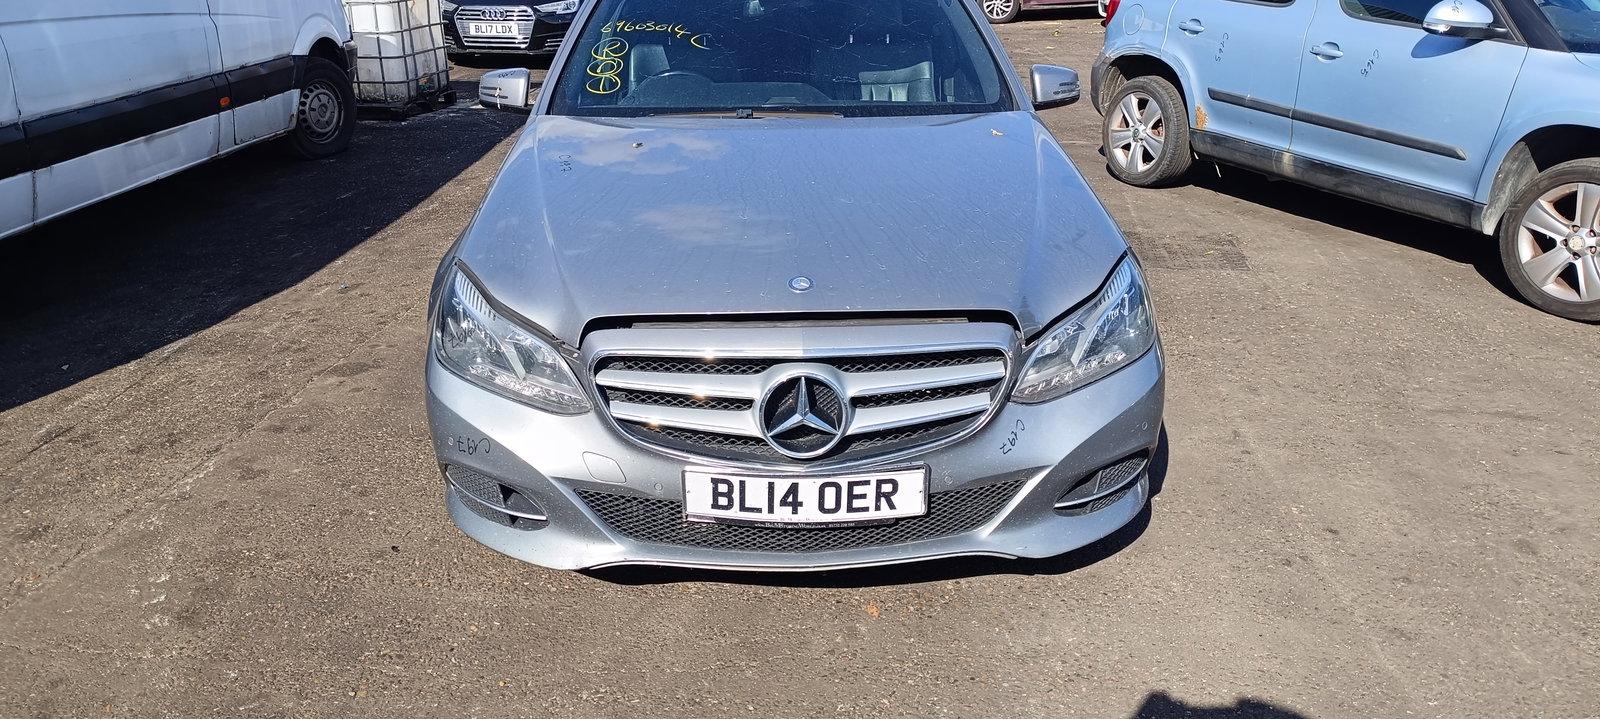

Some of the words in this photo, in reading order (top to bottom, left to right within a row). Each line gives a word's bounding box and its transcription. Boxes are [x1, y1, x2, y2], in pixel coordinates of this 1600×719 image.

[474, 24, 493, 34] BL17
[495, 25, 513, 34] LDX
[457, 436, 490, 455] C197
[999, 419, 1025, 455] C197
[710, 477, 803, 515] BL14
[818, 478, 899, 514] OER
